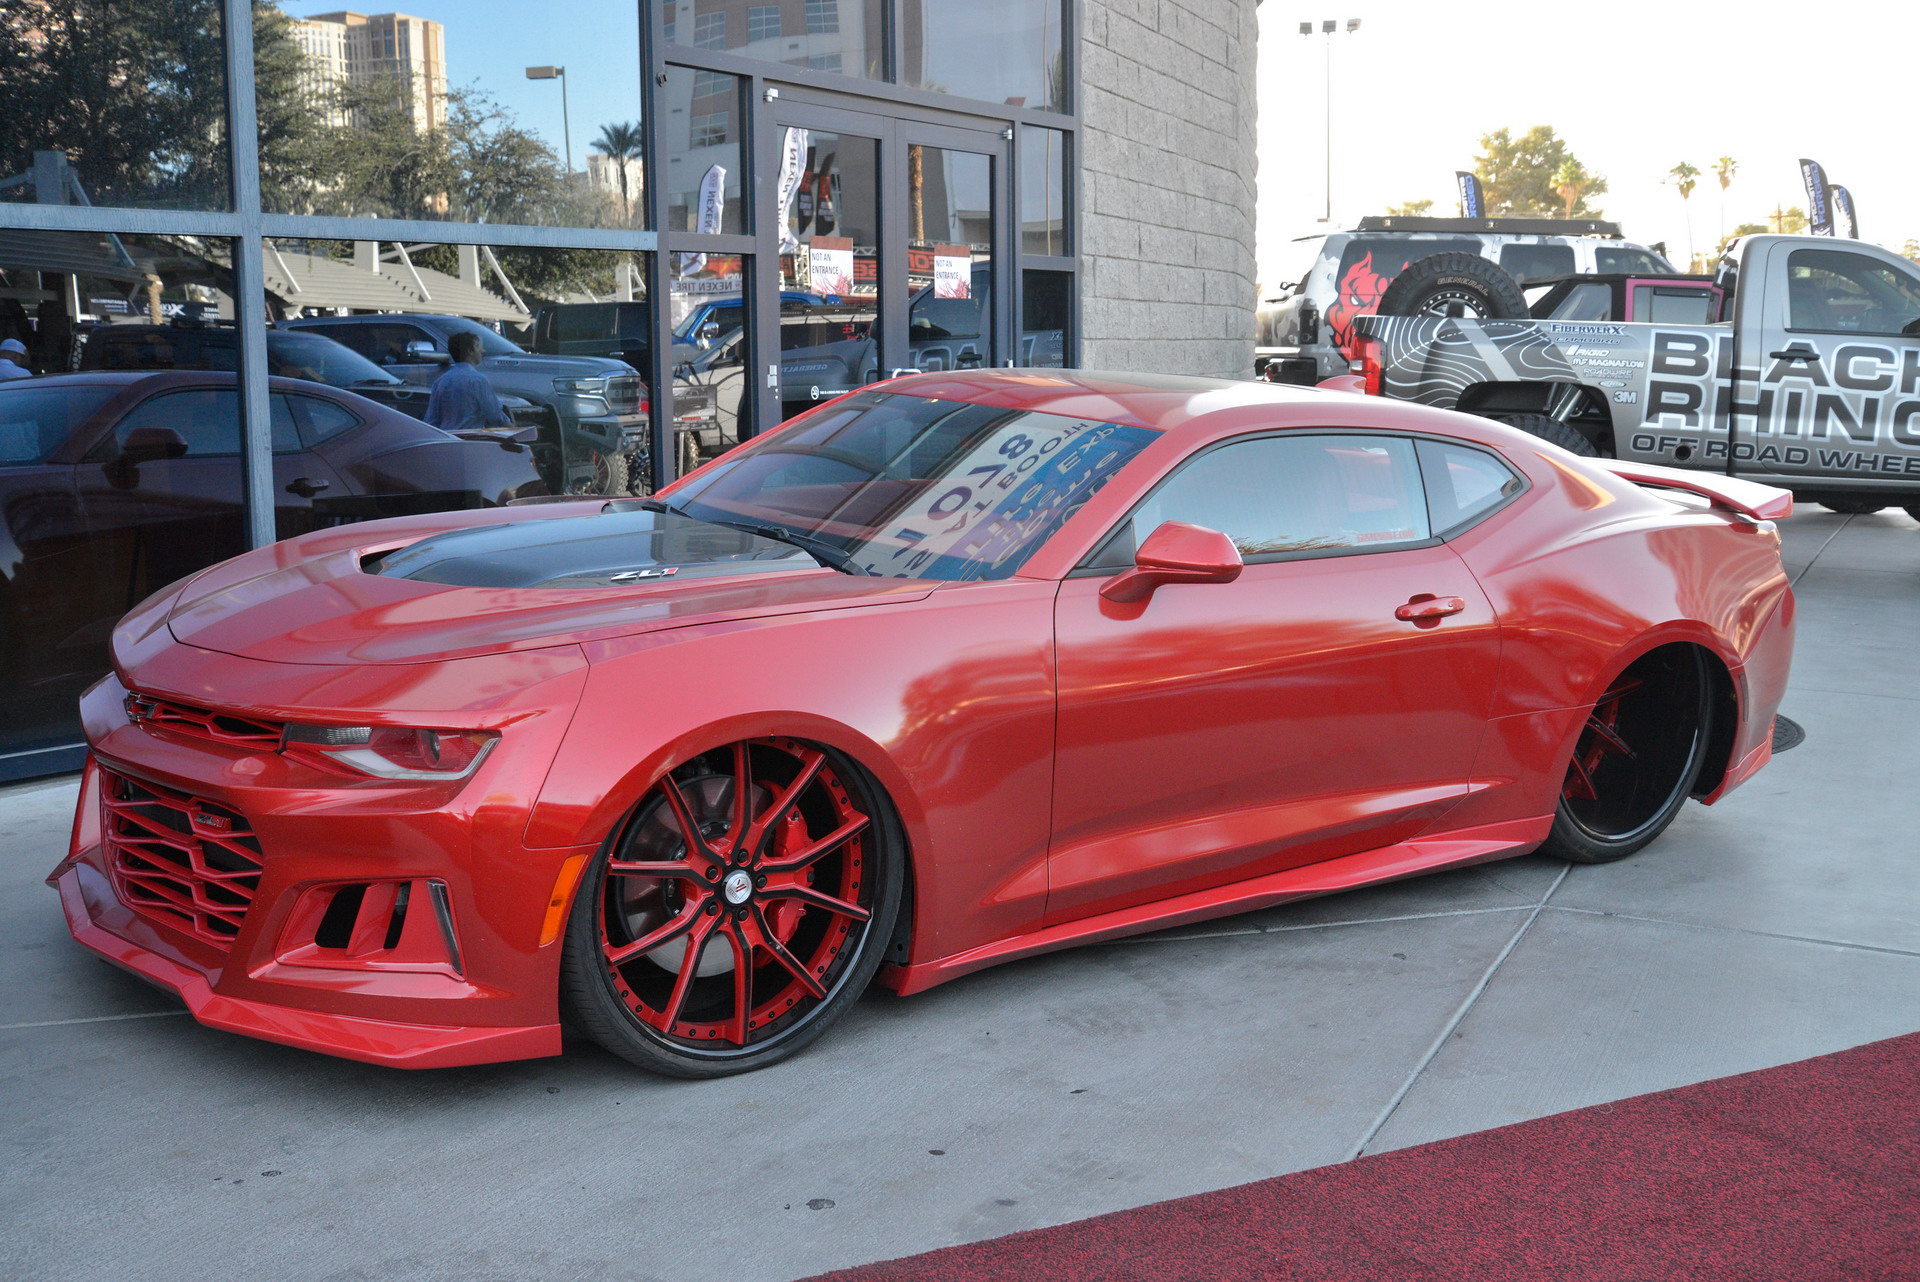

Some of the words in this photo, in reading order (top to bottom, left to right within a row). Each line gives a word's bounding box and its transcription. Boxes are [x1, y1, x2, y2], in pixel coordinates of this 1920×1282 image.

[1809, 163, 1825, 223] FORGED
[811, 252, 823, 262] NOT
[823, 253, 832, 262] AN
[935, 259, 945, 267] NOT
[946, 260, 953, 268] AN
[811, 265, 839, 275] ENTRANCE
[935, 271, 959, 280] ENTRANCE
[1437, 276, 1489, 297] GENERAL
[1574, 347, 1610, 357] RIGID
[1588, 358, 1645, 369] MAGNAFLOW
[1649, 328, 1920, 397] BLAC
[1613, 390, 1637, 404] 3M
[1703, 439, 1810, 467] ROAD
[610, 567, 679, 581] ZL1
[194, 813, 225, 827] ZL1
